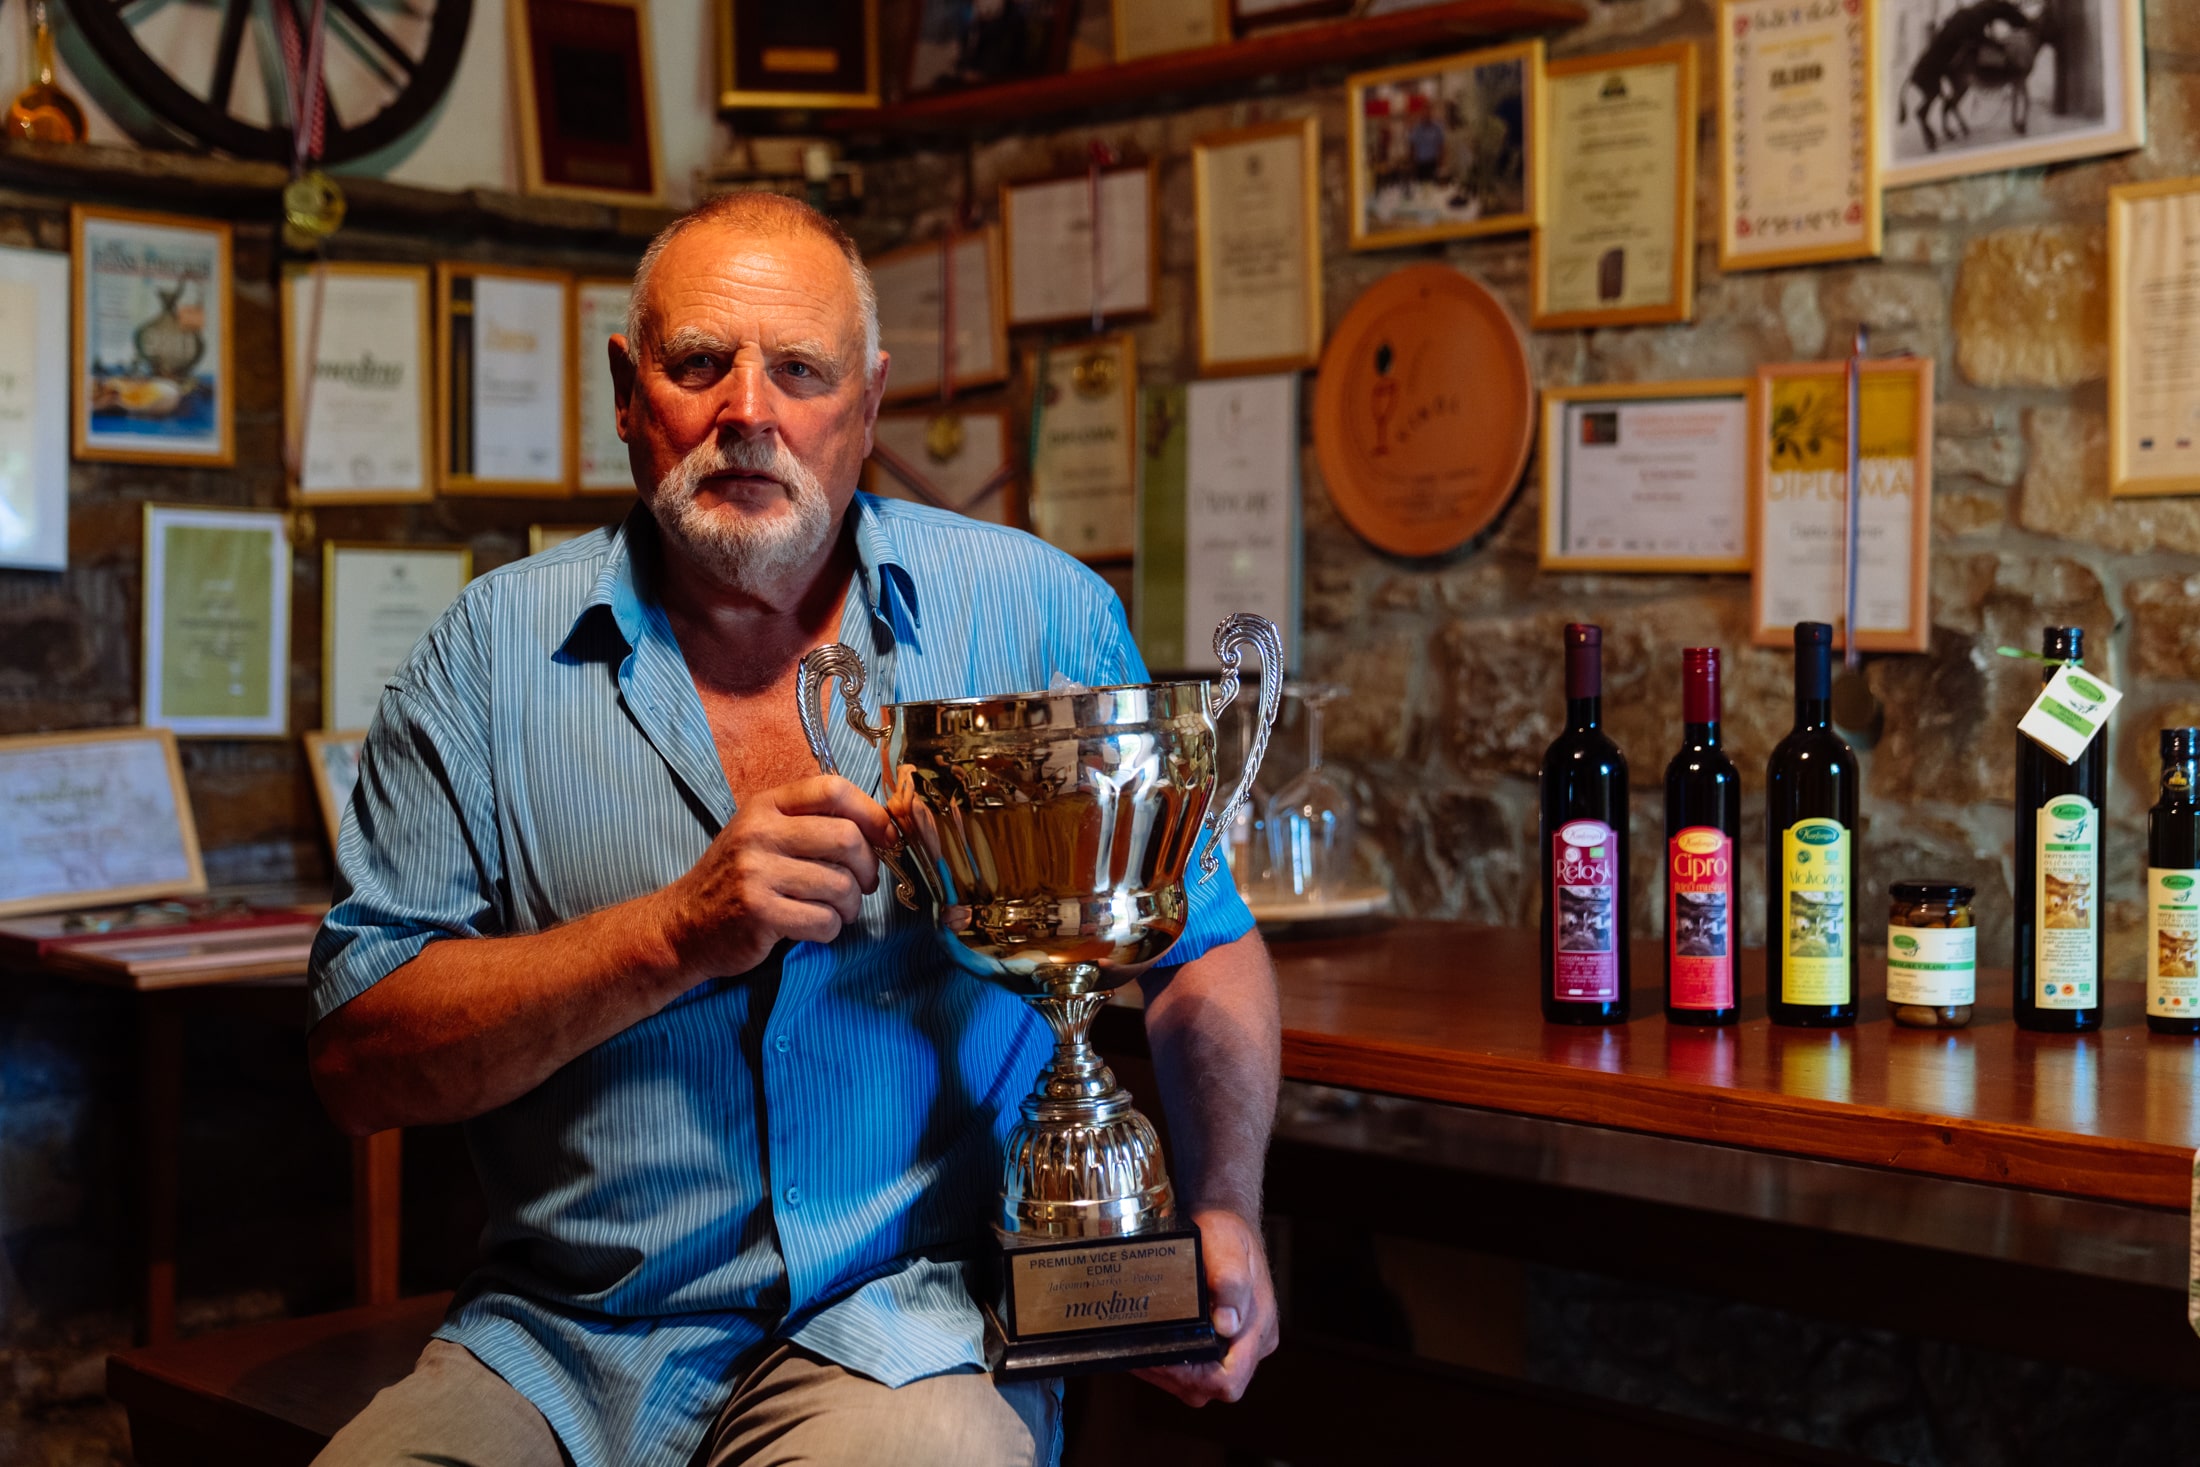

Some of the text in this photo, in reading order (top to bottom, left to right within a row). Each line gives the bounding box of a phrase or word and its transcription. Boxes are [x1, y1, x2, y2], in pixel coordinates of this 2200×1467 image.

[1674, 852, 1728, 882] Cipro
[1030, 1246, 1176, 1270] PREMIUM VICE ŠAMPION
[1086, 1264, 1121, 1276] EDMU
[1065, 1290, 1150, 1320] maslina
